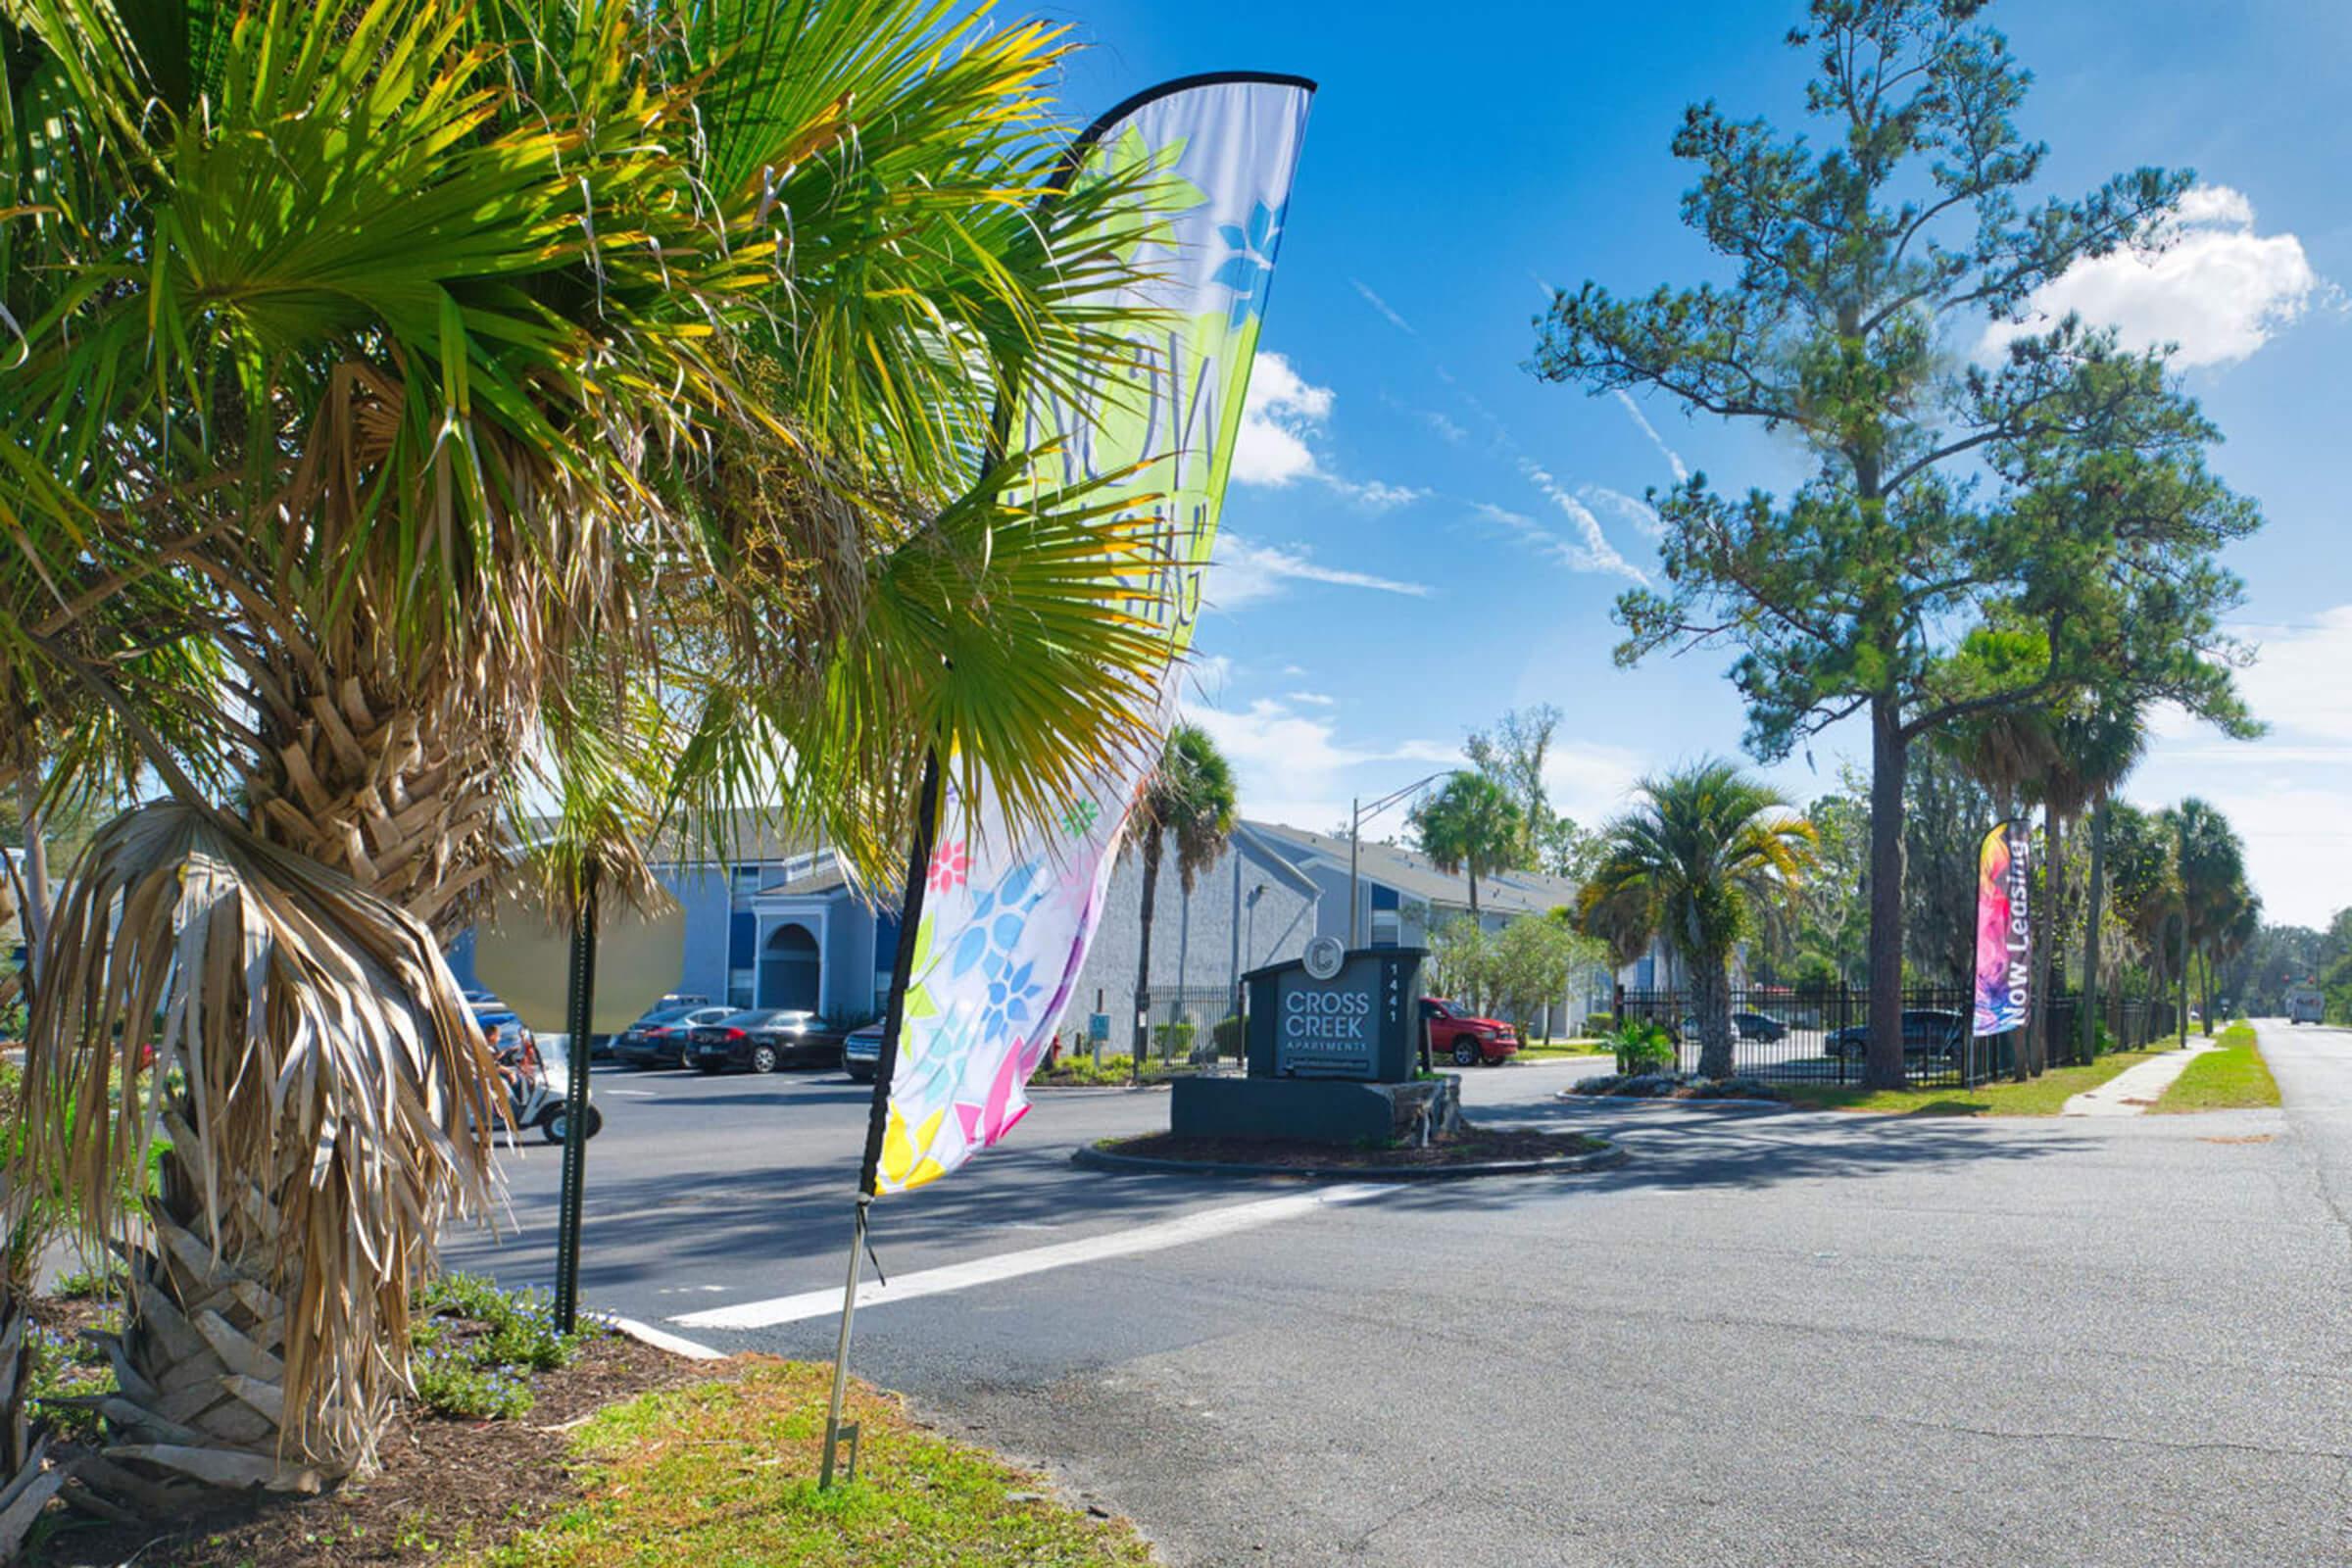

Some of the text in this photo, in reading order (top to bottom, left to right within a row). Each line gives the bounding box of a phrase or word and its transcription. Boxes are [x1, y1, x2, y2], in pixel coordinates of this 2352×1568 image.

[2002, 840, 2030, 1025] Now Leasing
[1286, 992, 1369, 1014] CROSS
[1285, 1015, 1363, 1039] CREEK
[1286, 1042, 1367, 1052] APARTMENTS
